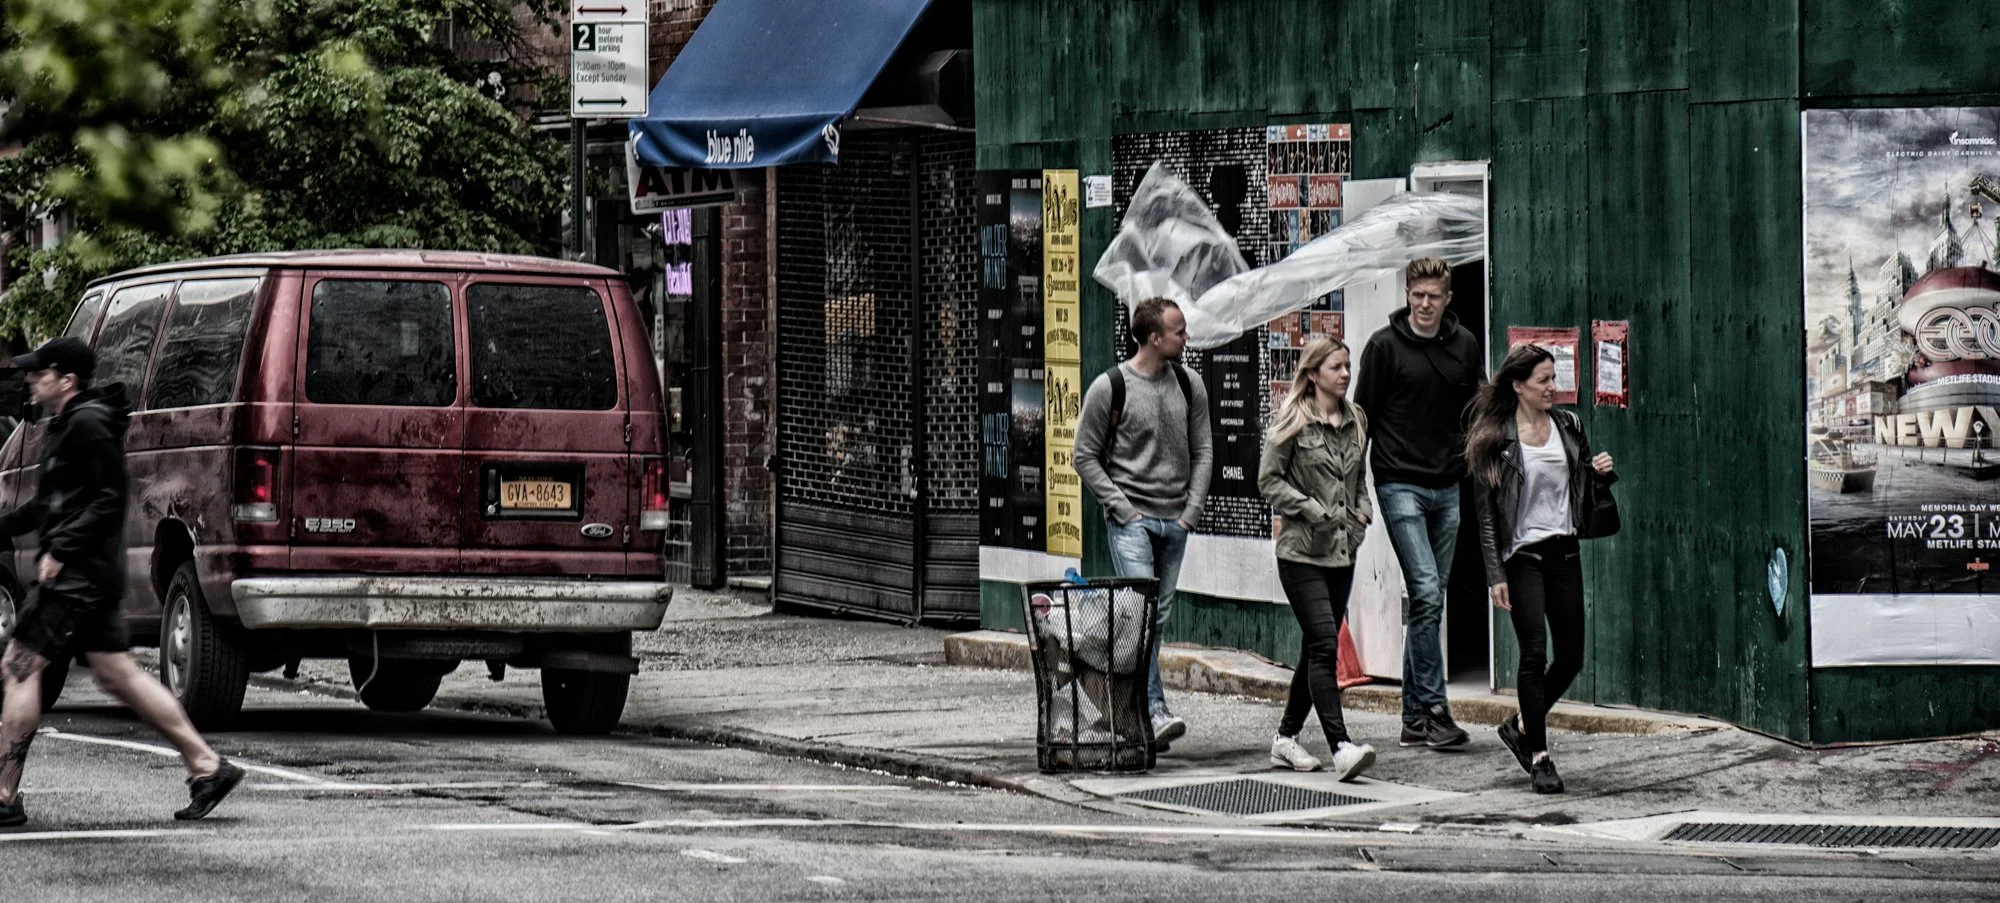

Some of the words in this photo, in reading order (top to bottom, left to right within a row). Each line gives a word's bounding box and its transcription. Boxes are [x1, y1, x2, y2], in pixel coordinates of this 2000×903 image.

[577, 24, 590, 50] 2
[598, 27, 612, 35] hour
[598, 35, 623, 44] metered
[598, 44, 621, 53] parking
[576, 61, 600, 71] 7:30am
[607, 61, 626, 72] 10pm
[576, 73, 599, 84] Except
[601, 73, 627, 84] Sunday
[704, 129, 731, 164] blue
[733, 127, 755, 163] nile
[635, 165, 735, 199] ATM
[980, 224, 1008, 257] WILDER
[983, 257, 1007, 290] MIND
[1937, 373, 1971, 387] METLIFE
[982, 412, 1009, 446] WILDER
[1874, 406, 1975, 449] NEW
[985, 446, 1008, 479] MIND
[1222, 465, 1244, 480] CHANEL
[1921, 504, 1967, 512] MEMORIAL
[1969, 504, 1987, 512] DAY
[1887, 521, 1928, 539] MAY
[1930, 514, 1965, 539] 23
[1927, 539, 1974, 549] METLIFE
